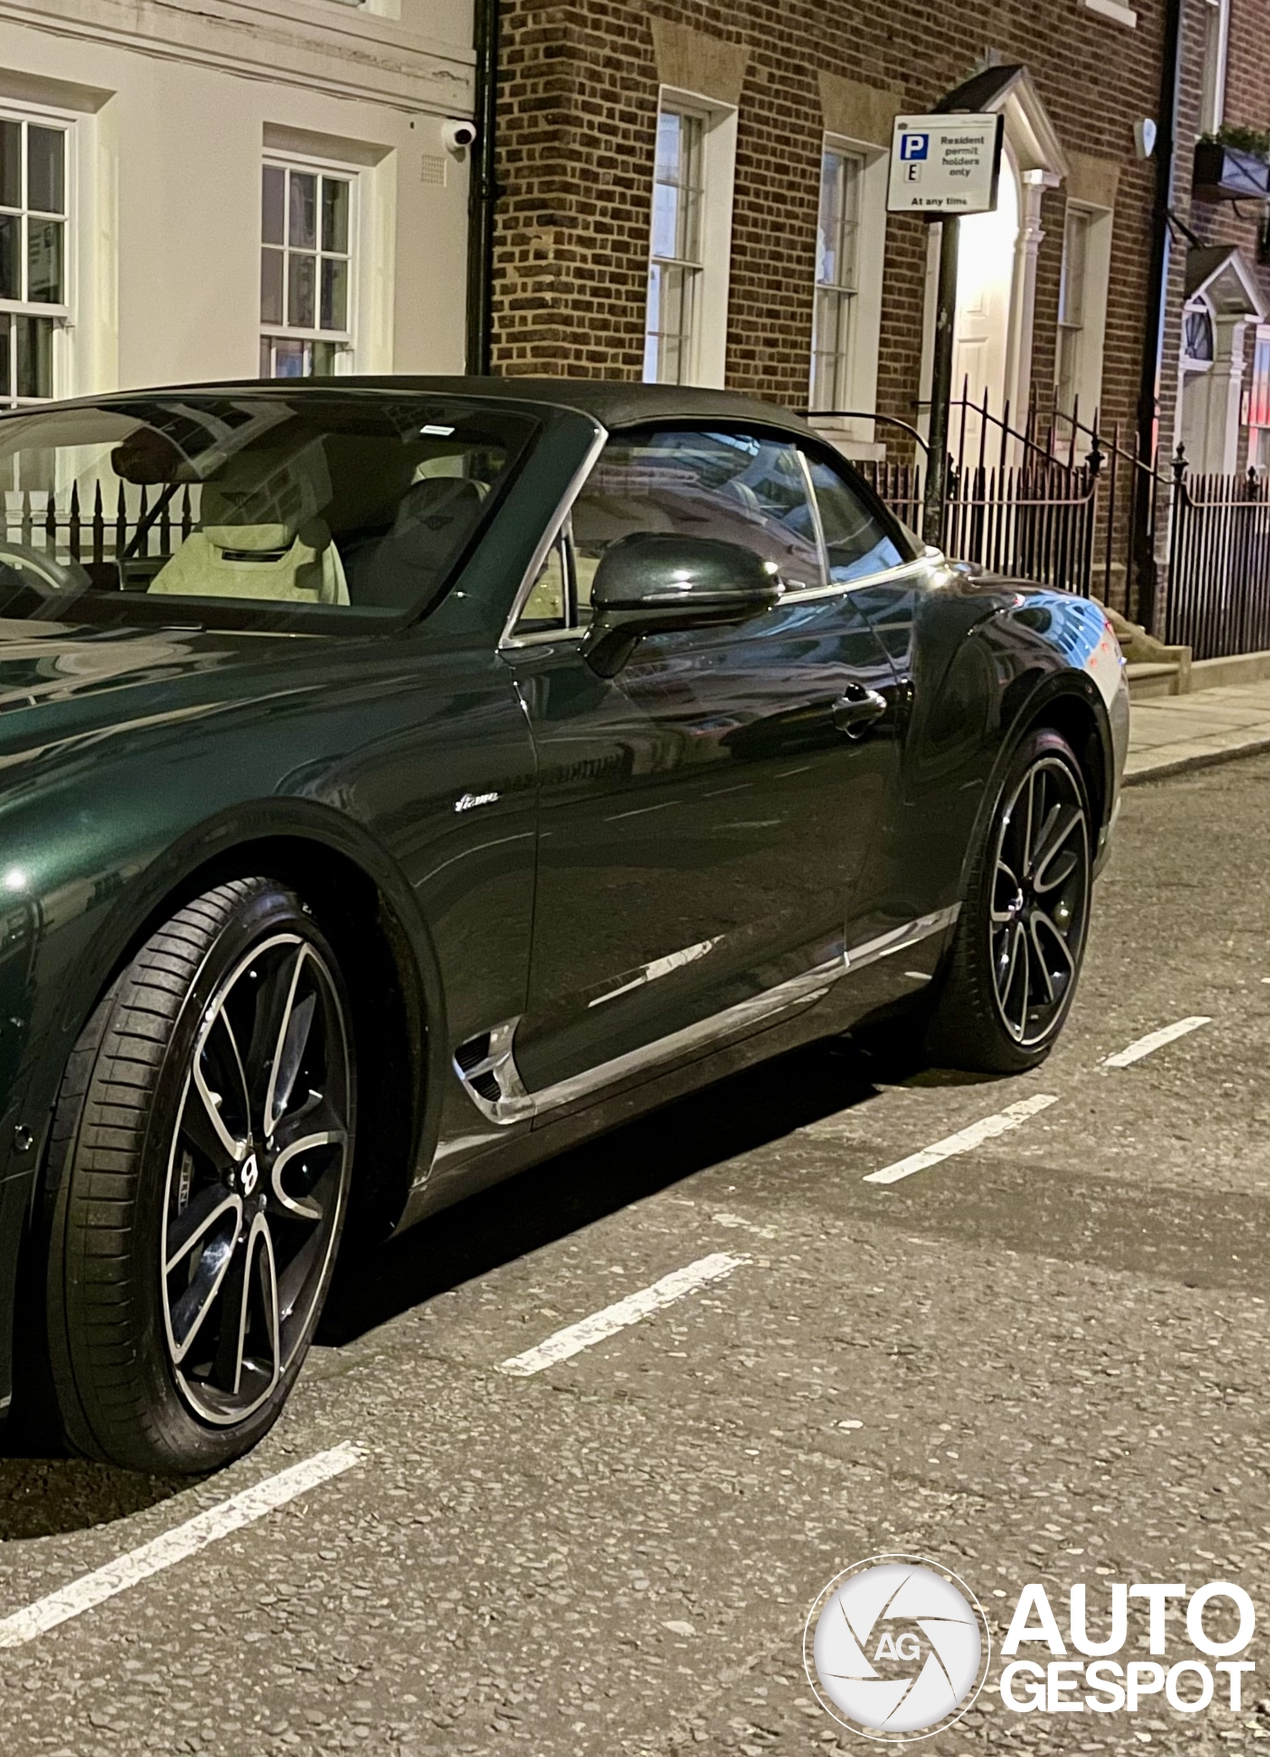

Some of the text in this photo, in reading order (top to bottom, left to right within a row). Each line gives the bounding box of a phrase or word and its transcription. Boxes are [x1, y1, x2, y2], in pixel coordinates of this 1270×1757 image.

[940, 136, 985, 145] Resident
[905, 135, 925, 159] P
[945, 147, 978, 156] permit
[942, 157, 980, 165] holders
[908, 164, 917, 181] E
[949, 168, 971, 178] only
[911, 197, 968, 207] At any time
